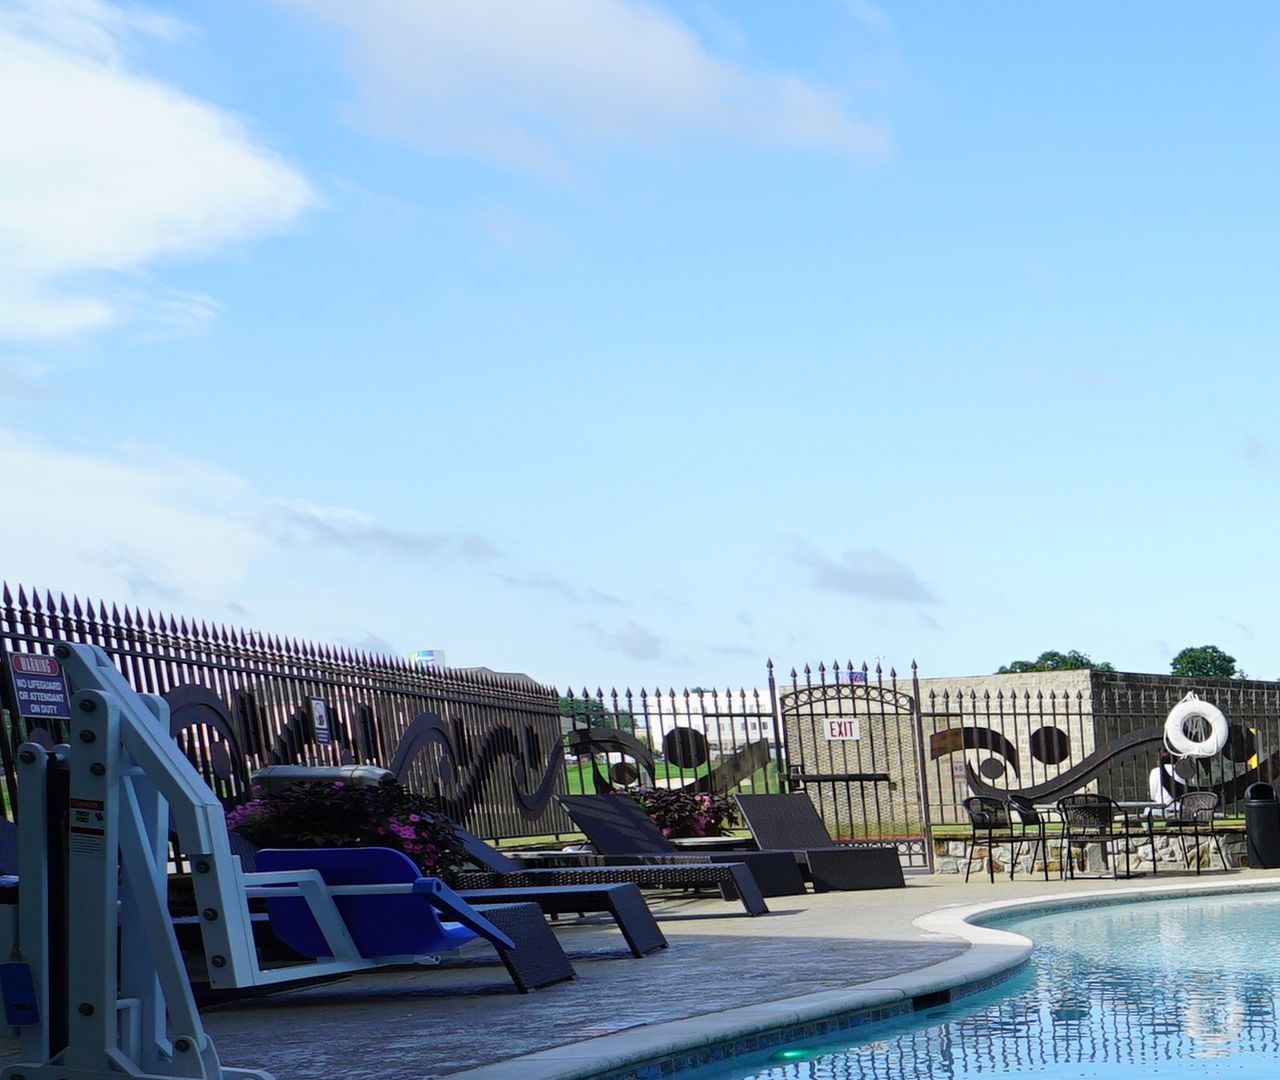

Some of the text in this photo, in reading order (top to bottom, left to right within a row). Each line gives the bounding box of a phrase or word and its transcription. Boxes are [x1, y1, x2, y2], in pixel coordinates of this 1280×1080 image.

[20, 657, 52, 673] WARNING
[16, 678, 62, 690] NO LIFEGUARD
[19, 691, 64, 703] OR ATTENDANT
[30, 703, 57, 714] ON DUTY
[829, 721, 854, 738] EXIT
